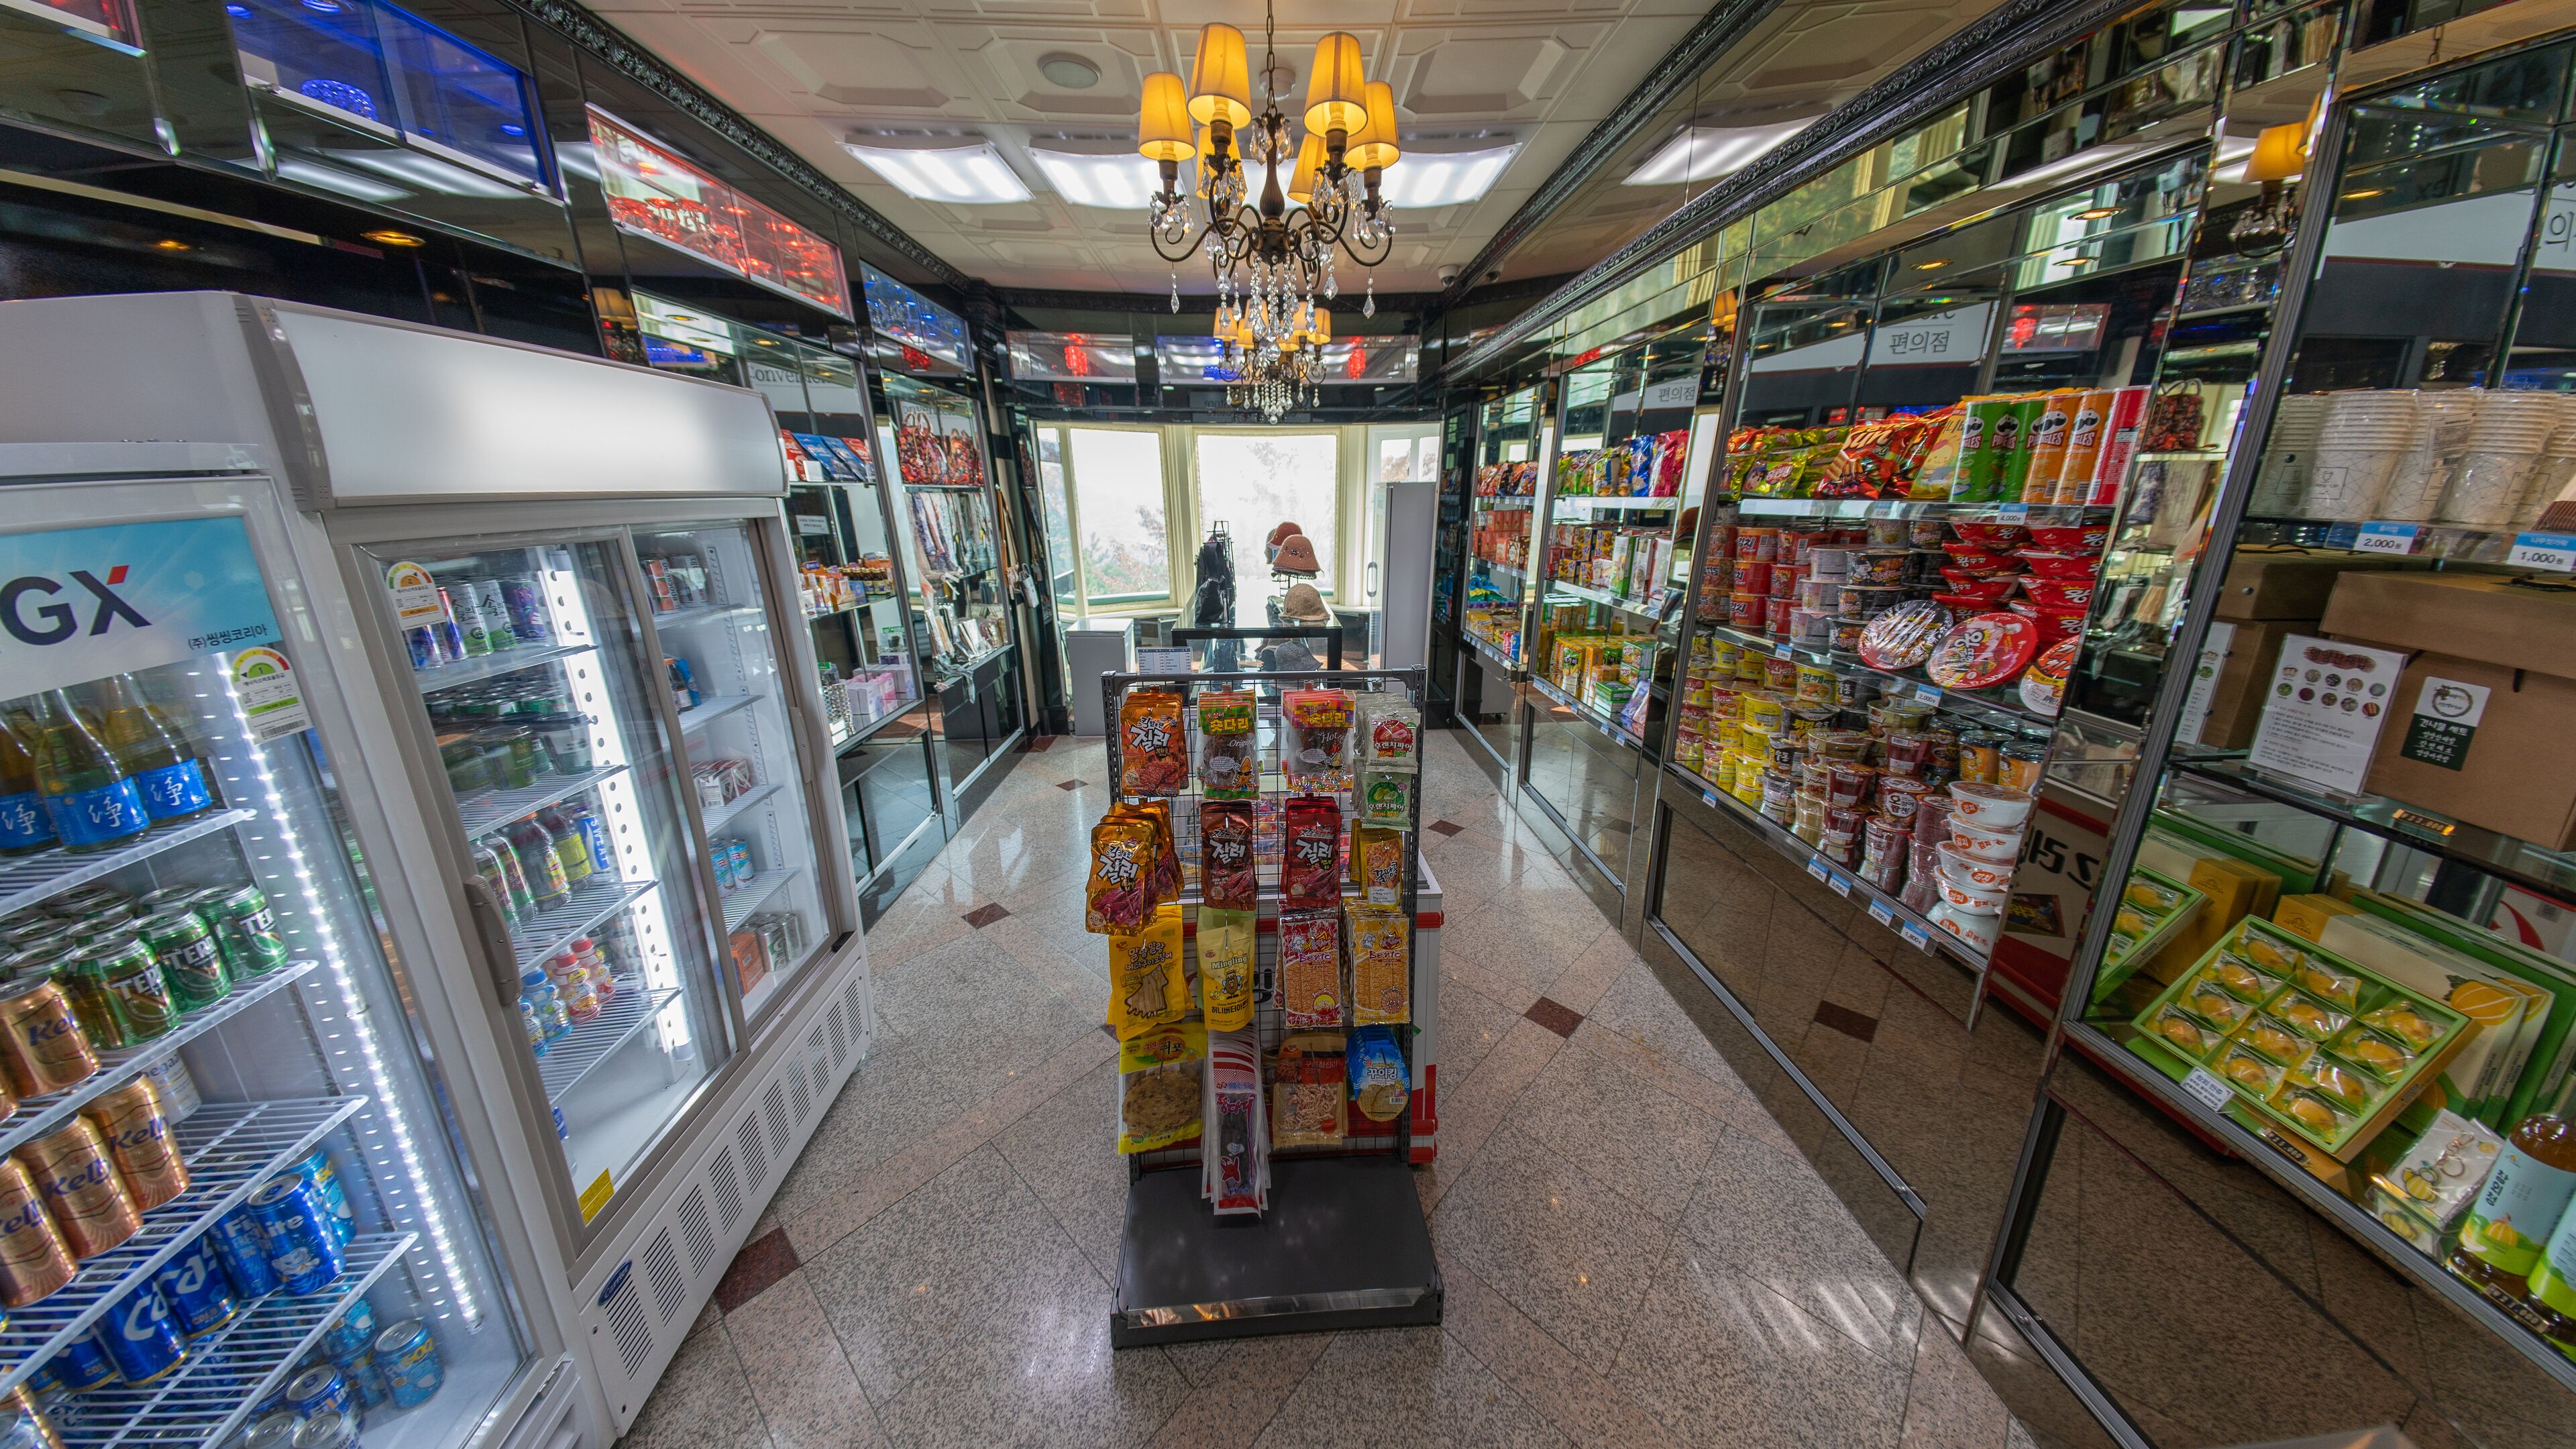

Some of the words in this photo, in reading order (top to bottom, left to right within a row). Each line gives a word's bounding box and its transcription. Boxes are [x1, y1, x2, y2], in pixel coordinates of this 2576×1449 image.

[1890, 330, 1949, 354] 편의점
[1658, 385, 1696, 402] 편의점
[2363, 538, 2402, 549] 2,000원
[2520, 551, 2565, 565] 1,000원
[188, 624, 268, 651] (주)씽씽코리아
[1210, 717, 1249, 733] 숏다리
[1130, 725, 1171, 753] 질러
[1374, 741, 1413, 753] 후렌치파이
[1368, 803, 1405, 812] 후렌치파이
[590, 817, 610, 865] SWEAT
[1295, 839, 1334, 865] 질러
[1373, 860, 1399, 883] 꿀땅콩
[1128, 941, 1166, 963] 말랑말랑
[1299, 952, 1332, 964] Bento
[1368, 950, 1402, 960] Bento
[1125, 951, 1173, 971] 버터구이오징어
[1211, 955, 1248, 970] Mingling
[1367, 1067, 1398, 1079] 꾸이킹
